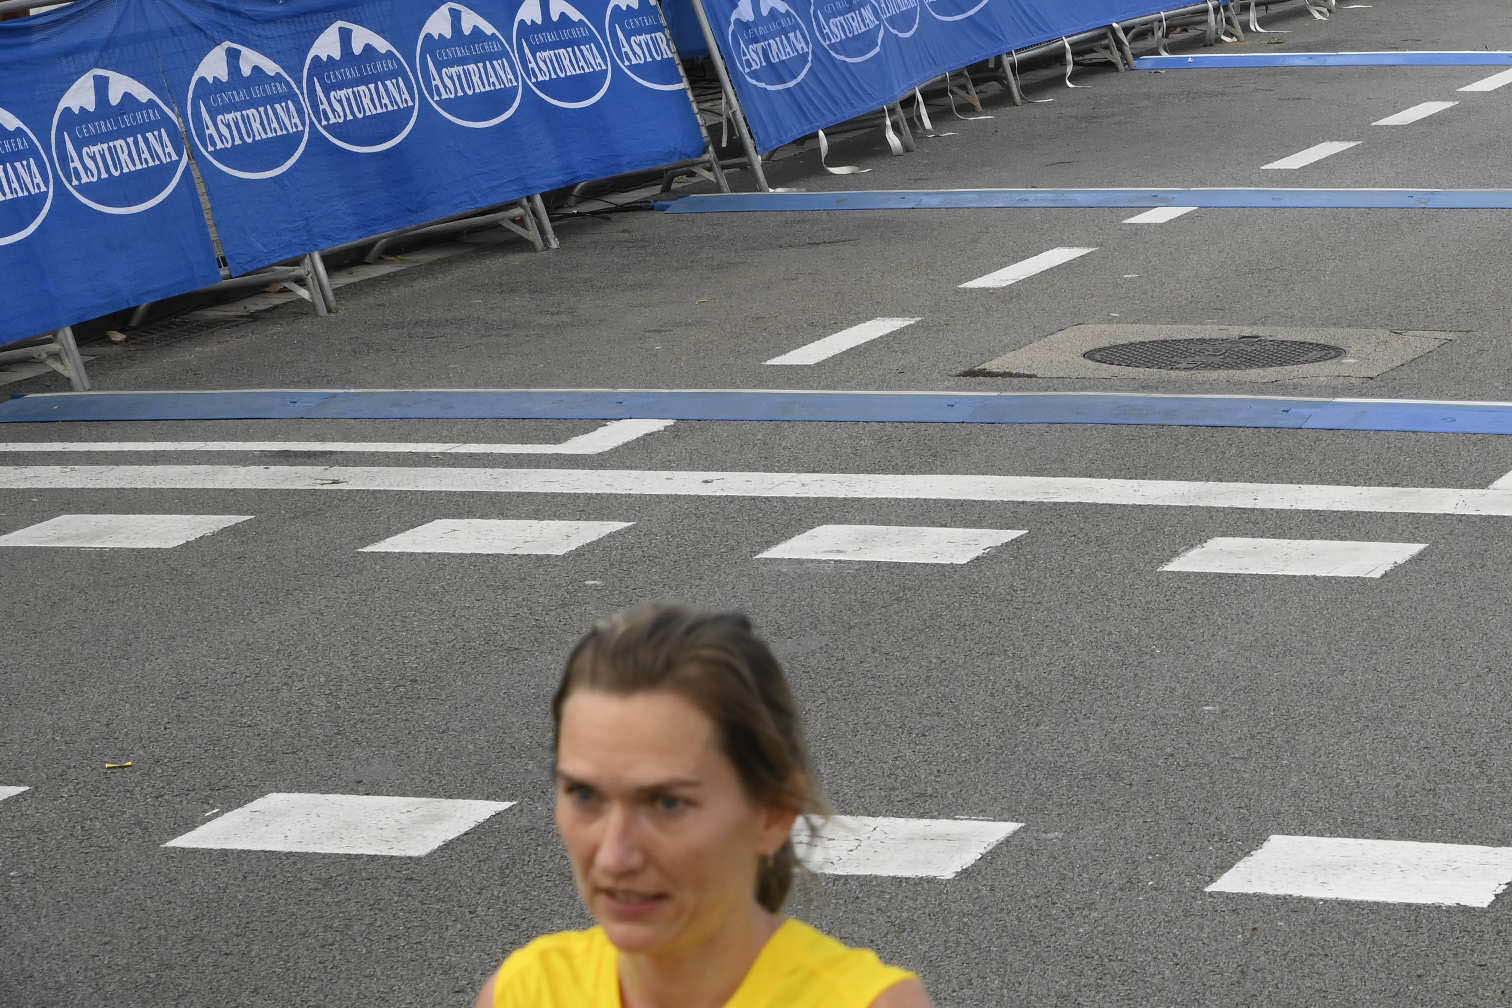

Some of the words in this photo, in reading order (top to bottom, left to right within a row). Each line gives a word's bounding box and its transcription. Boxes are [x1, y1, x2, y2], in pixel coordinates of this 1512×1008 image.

[426, 54, 517, 101] ASTURIANA
[521, 38, 607, 83] ASTURIANA
[200, 99, 304, 152] ASTURIANA
[313, 76, 413, 127] ASTURIANA
[64, 128, 178, 186] ASTURIANA
